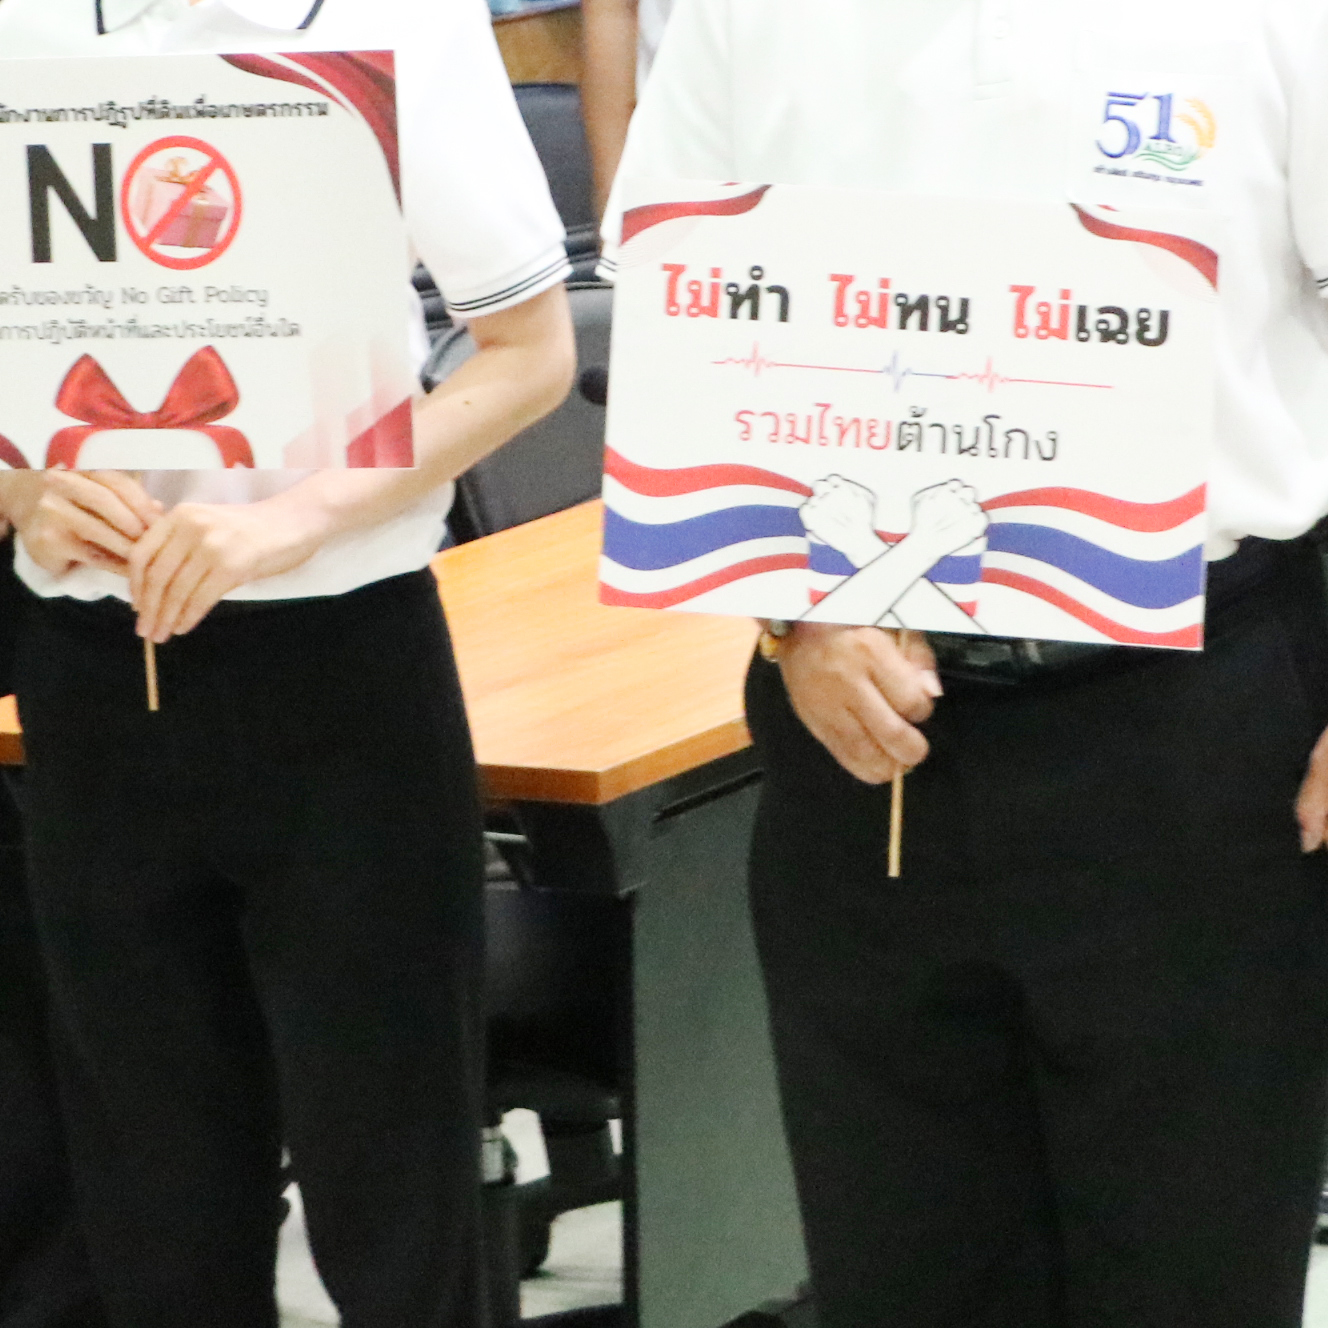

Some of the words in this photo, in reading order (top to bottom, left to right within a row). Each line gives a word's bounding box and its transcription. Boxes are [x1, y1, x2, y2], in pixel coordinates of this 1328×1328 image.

[1094, 91, 1177, 159] 51
[121, 286, 149, 304] No
[157, 285, 197, 305] Gift
[204, 285, 270, 308] Policy
[662, 263, 791, 324] ไม่ทำ
[830, 273, 970, 335] ไม่ทน
[1010, 284, 1170, 348] ไม่เฉย
[734, 402, 1058, 462] รวมไทยต้านโกง
